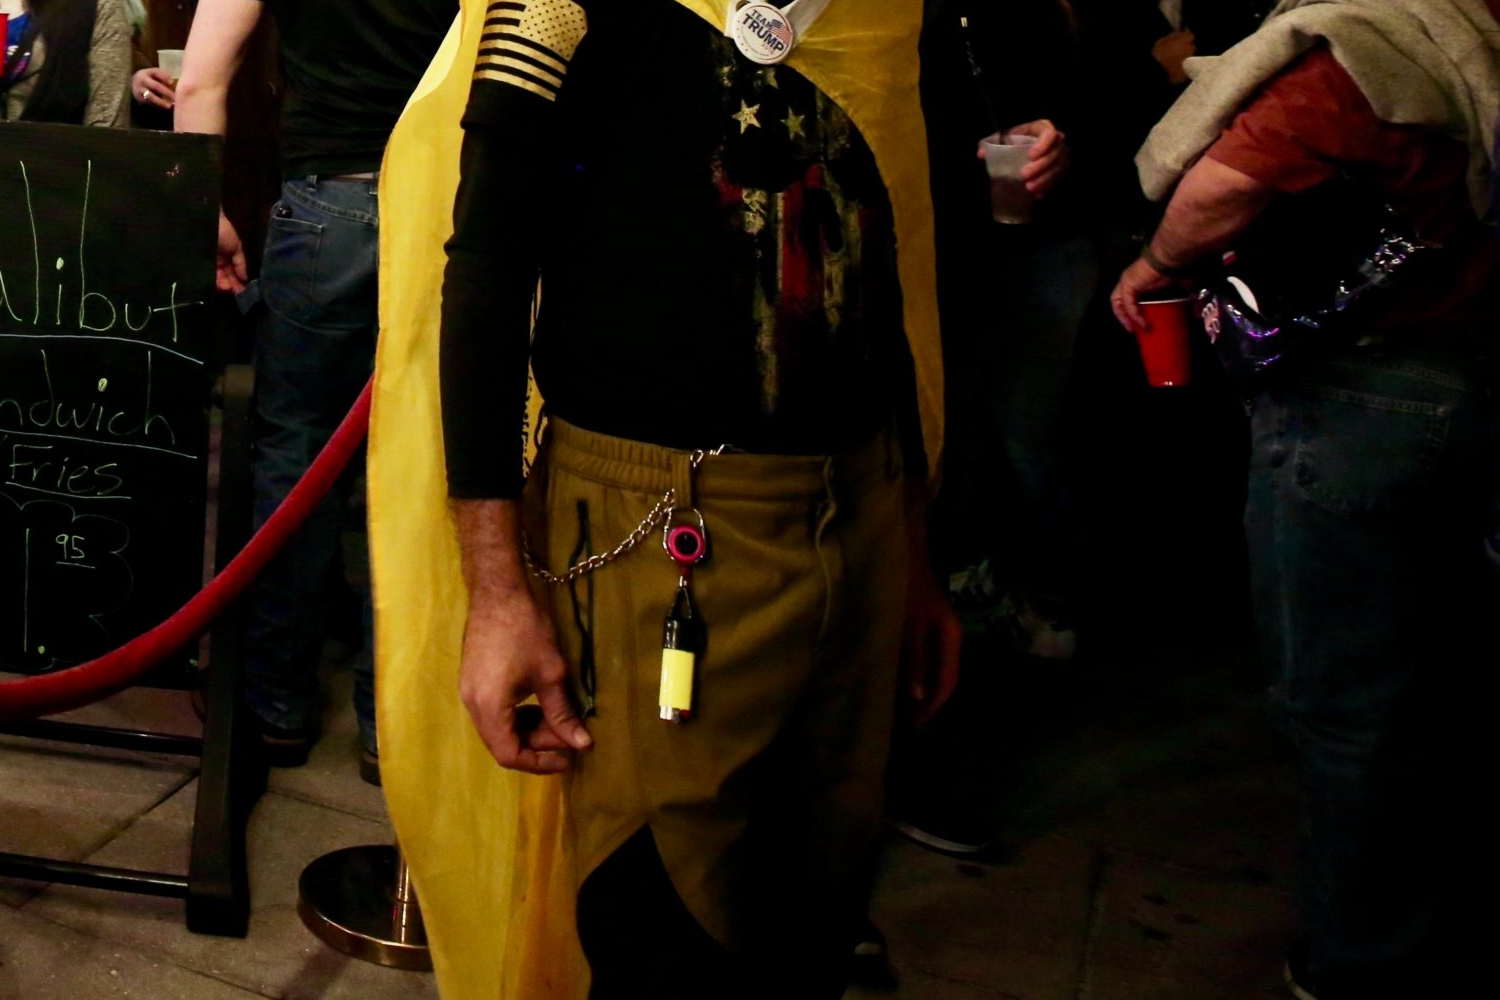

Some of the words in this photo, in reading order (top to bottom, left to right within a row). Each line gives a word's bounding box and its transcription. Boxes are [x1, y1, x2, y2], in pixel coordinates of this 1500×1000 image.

[742, 13, 785, 51] TRUMP
[751, 9, 773, 29] TEAM
[8, 443, 118, 494] Fries
